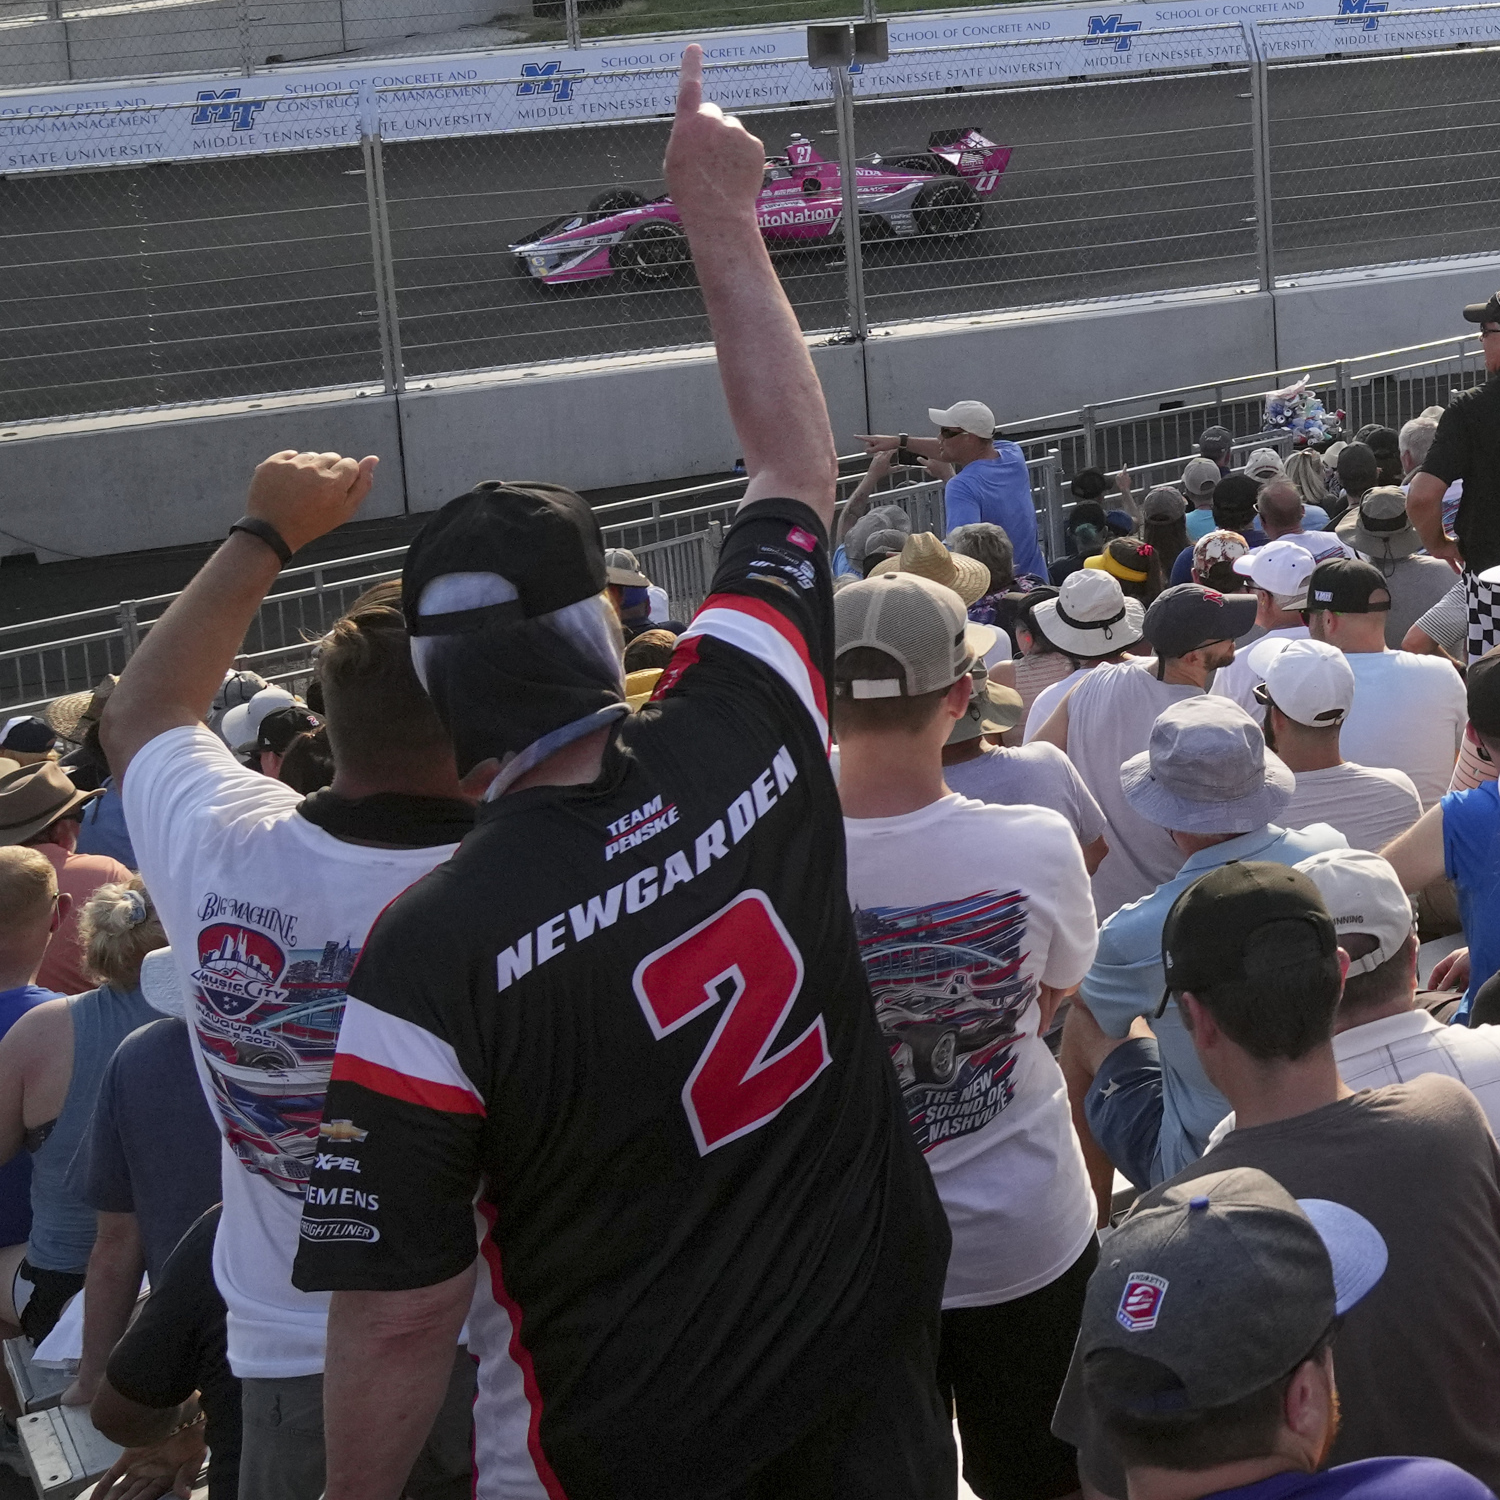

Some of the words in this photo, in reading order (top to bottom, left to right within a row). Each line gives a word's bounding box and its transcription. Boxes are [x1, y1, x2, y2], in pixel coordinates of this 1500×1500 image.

[1155, 8, 1203, 21] SCHOOL
[1205, 5, 1220, 17] OF
[1222, 2, 1279, 16] CONCRETE
[1281, 0, 1306, 11] AND
[889, 29, 940, 43] SCHOOL
[943, 27, 960, 39] OF
[962, 21, 1023, 37] CONCRETE
[1025, 20, 1052, 32] AND
[1084, 13, 1142, 52] MT
[1334, 32, 1380, 47] MIDDLE
[1383, 27, 1446, 43] TENNESSEE
[1449, 23, 1482, 37] STATE
[600, 54, 656, 69] SCHOOL
[658, 51, 677, 63] OF
[749, 44, 777, 55] AND
[1083, 53, 1133, 68] MIDDLE
[1136, 48, 1204, 64] TENNESSEE
[1207, 44, 1242, 58] STATE
[284, 82, 342, 95] SCHOOL
[371, 72, 446, 88] CONCRETE
[448, 68, 478, 81] AND
[517, 60, 586, 103] MT
[870, 69, 943, 87] TENNESSEE
[946, 66, 985, 80] STATE
[988, 59, 1063, 77] UNIVERSITY
[114, 97, 147, 110] AND
[190, 87, 267, 132] MT
[390, 84, 489, 104] MANAGEMENT
[516, 104, 575, 120] MIDDLE
[580, 96, 657, 115] TENNESSEE
[708, 84, 790, 102] UNIVERSITY
[51, 113, 160, 134] MANAGEMENT
[192, 133, 256, 150] MIDDLE
[263, 125, 348, 144] TENNESSEE
[404, 112, 492, 132] UNIVERSITY
[8, 151, 57, 167] STATE
[64, 142, 164, 162] UNIVERSITY
[796, 145, 812, 164] 27
[606, 794, 664, 837] TEAM
[604, 805, 682, 862] PENSKE
[496, 744, 799, 993] NEWGARDEN
[197, 891, 228, 922] BIG
[228, 899, 299, 948] MACHINE
[200, 970, 244, 992] MUSIC
[244, 979, 286, 1002] CITY
[196, 1002, 272, 1039] INAUGURAL
[632, 888, 834, 1158] 2
[244, 1035, 277, 1049] 2021
[924, 1090, 958, 1105] THE
[960, 1068, 993, 1102] NEW
[924, 1095, 985, 1124] SOUND
[986, 1079, 1006, 1106] OF
[928, 1090, 1008, 1143] NASHVILLE
[314, 1152, 362, 1174] XPEL
